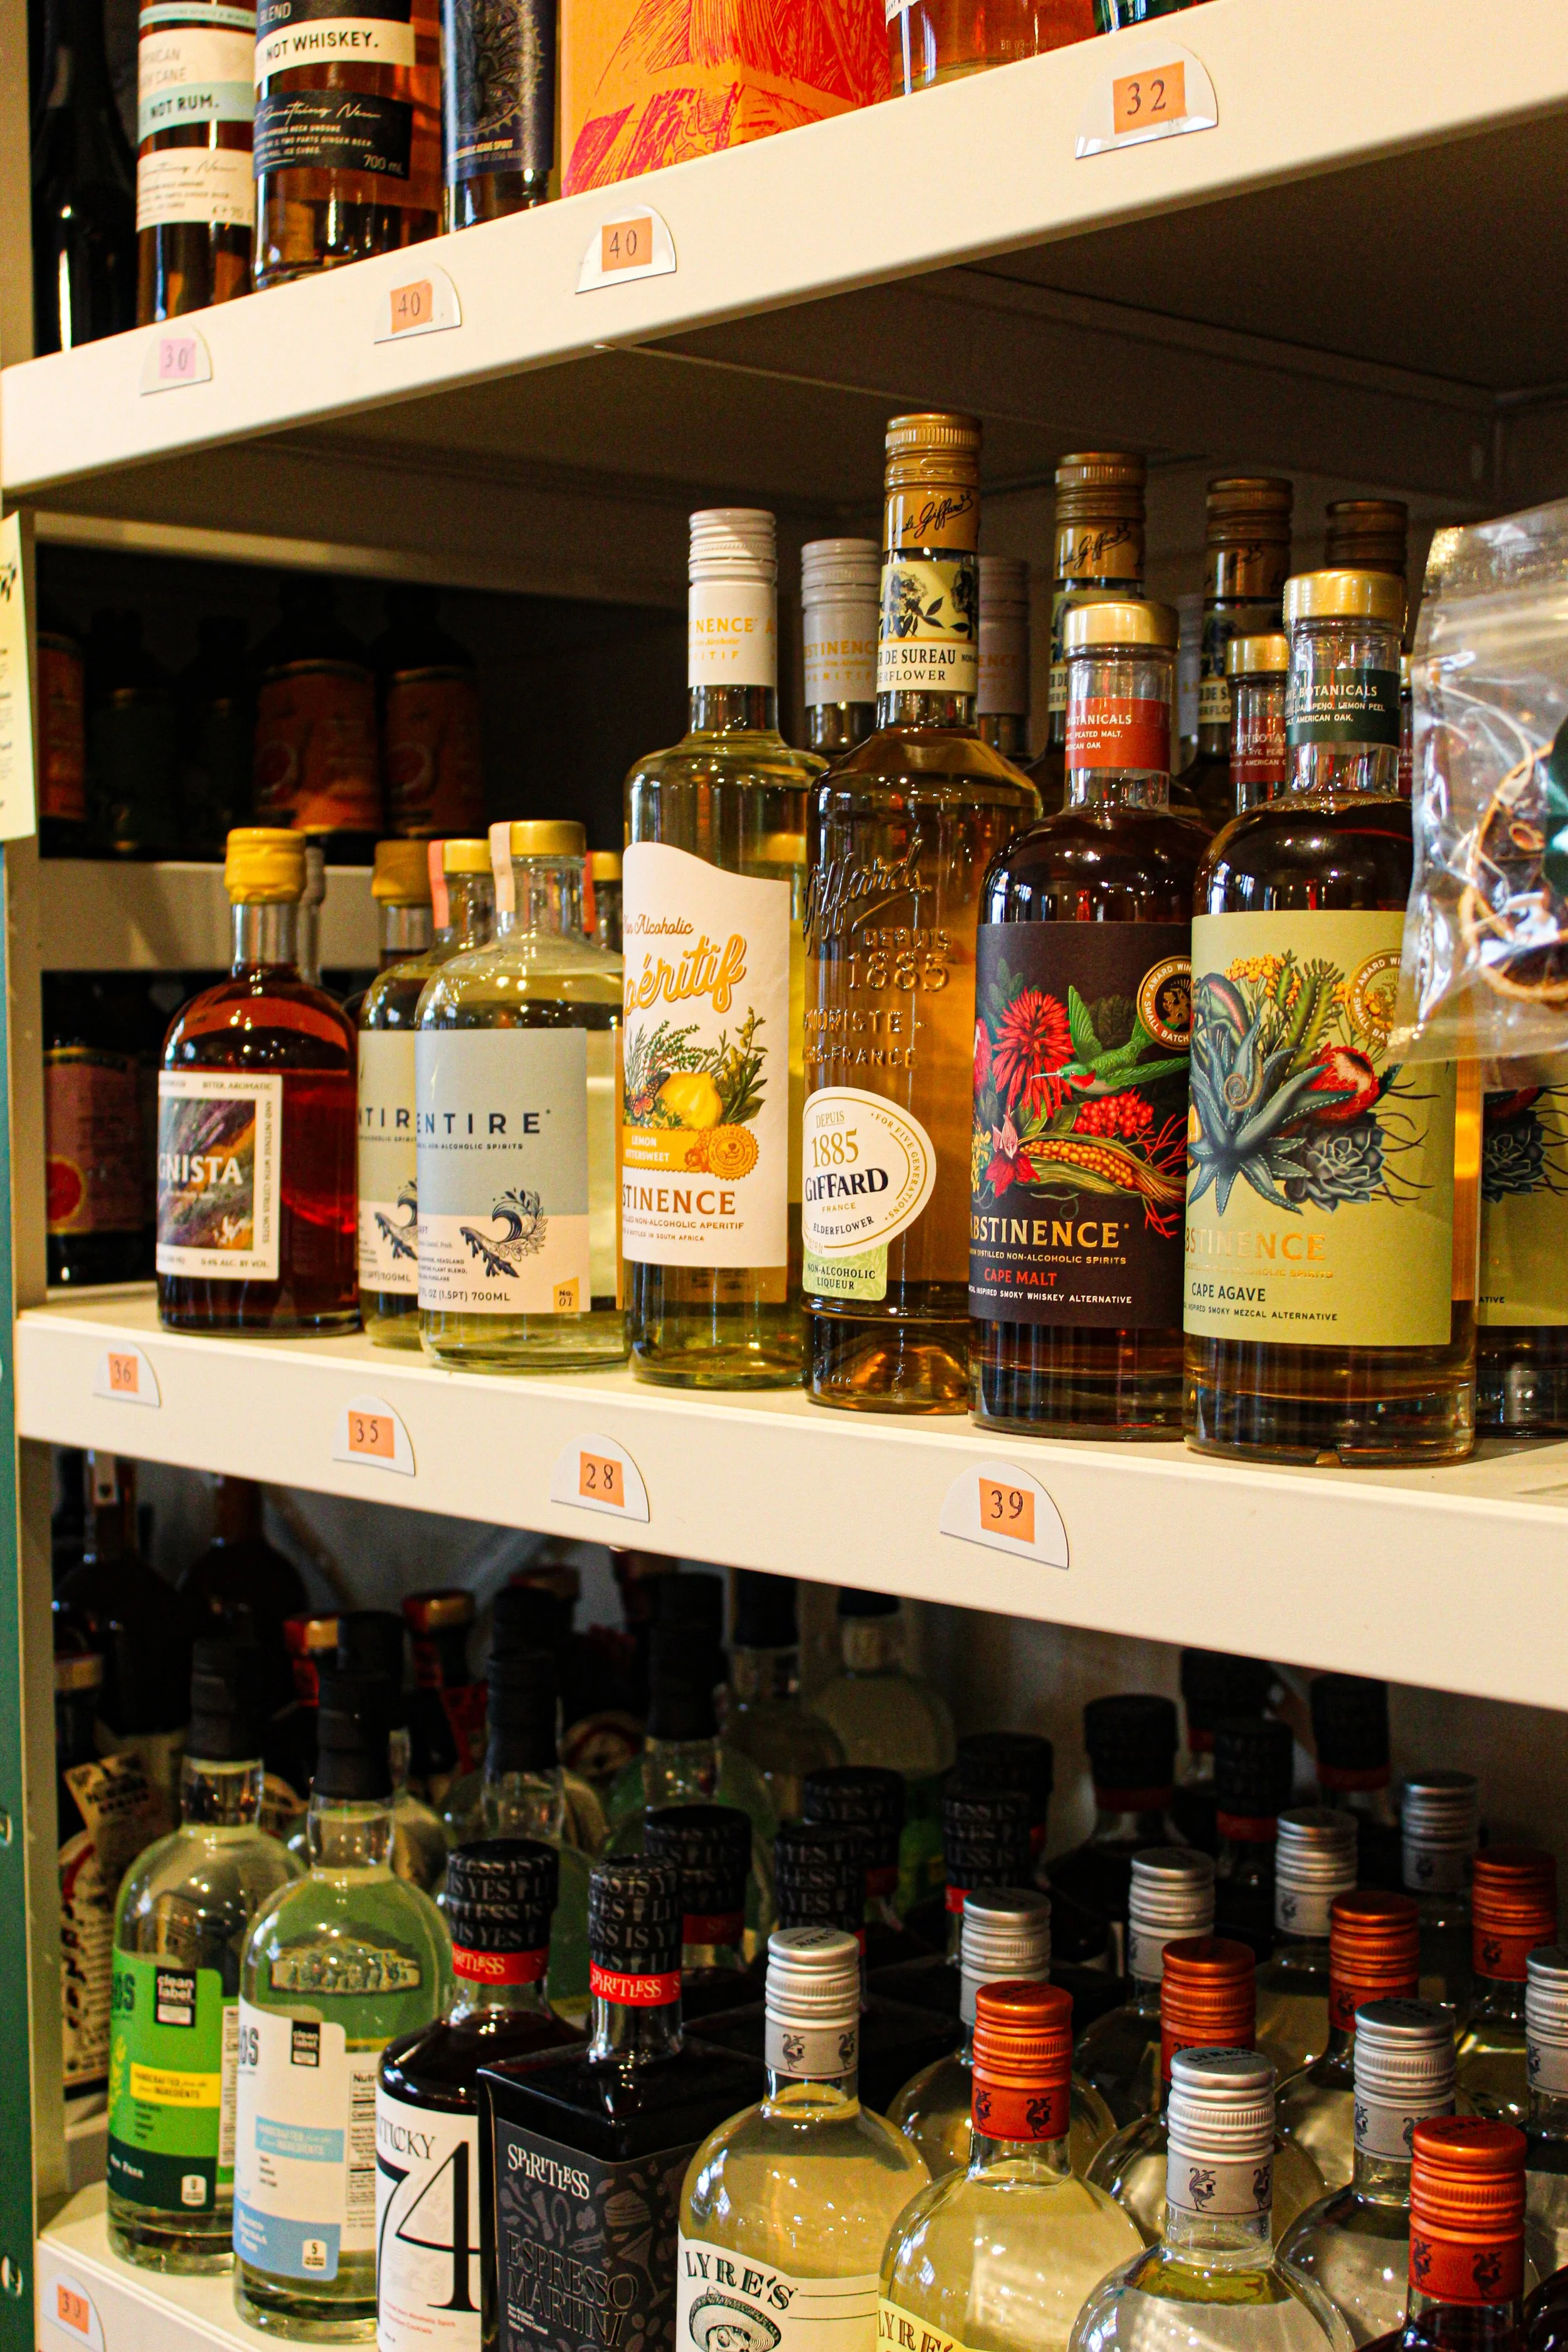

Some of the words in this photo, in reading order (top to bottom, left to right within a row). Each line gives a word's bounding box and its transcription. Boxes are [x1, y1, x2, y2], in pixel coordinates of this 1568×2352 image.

[267, 40, 289, 61] NOT
[293, 31, 379, 52] WHISKEY.
[151, 98, 172, 118] NOT
[177, 93, 219, 110] RUM.
[1127, 79, 1166, 115] 32
[363, 154, 386, 170] 700
[610, 230, 637, 259] 40
[398, 291, 420, 317] 40
[166, 344, 188, 371] 30
[688, 617, 753, 633] NENCE
[804, 640, 878, 658] STINENC
[885, 649, 897, 665] DE
[901, 649, 956, 665] SUREAU
[1299, 684, 1377, 697] BOTANICALS
[1338, 702, 1365, 710] LEMON
[1067, 714, 1132, 727] BOTANICALS
[1296, 714, 1330, 723] AMERICAN
[635, 914, 694, 935] Alcoholic
[622, 934, 746, 1019] péritif
[848, 951, 950, 992] 1885
[1147, 965, 1174, 990] AWARD
[1177, 963, 1192, 972] WIN
[1357, 957, 1386, 987] AWARD
[1390, 955, 1402, 965] WI
[1143, 1000, 1160, 1032] SMALL
[1160, 1029, 1189, 1043] BATCH
[1353, 997, 1369, 1030] SMALL
[1372, 1027, 1391, 1042] BAT
[815, 1110, 845, 1128] DEPUIS
[875, 1114, 894, 1128] FOR
[632, 1135, 657, 1147] LEMON
[894, 1127, 914, 1148] FIVE
[812, 1127, 859, 1168] 1885
[888, 1151, 921, 1218] GENERATIONS
[822, 1202, 856, 1213] FRANCE
[635, 1217, 697, 1228] NON-ALCOHOLIC
[813, 1216, 874, 1235] ELDERFLOWER
[1006, 1252, 1082, 1263] NON-ALCOHOLIC
[1086, 1256, 1126, 1264] SPIRITS
[807, 1263, 876, 1279] NON-ALCOHOLIC
[984, 1267, 1012, 1283] CAPE
[1015, 1271, 1057, 1286] MALT
[817, 1276, 855, 1290] LIQUEUR
[1192, 1282, 1214, 1298] CAPE
[1217, 1285, 1266, 1302] AGAVE
[428, 1289, 437, 1299] OZ
[438, 1290, 468, 1302] (1.5PT)
[471, 1291, 511, 1301] 700ML
[559, 1297, 573, 1307] 01
[976, 1286, 997, 1296] INSPIRED
[1000, 1290, 1024, 1300] SMOKY
[1027, 1293, 1064, 1302] WHISKEY
[1069, 1295, 1132, 1304] ALTERNATIVE
[1208, 1306, 1230, 1315] SMOKY
[1234, 1308, 1267, 1318] MEZCAL
[1271, 1311, 1338, 1321] ALTERNATIVE
[114, 1360, 130, 1383] 36
[356, 1419, 378, 1443] 35
[585, 1463, 613, 1490] 28
[990, 1490, 1024, 1519] 39
[467, 1877, 511, 1900] YES
[157, 1974, 194, 1989] clean
[158, 1986, 192, 2000] label
[292, 2030, 319, 2040] clean
[352, 2072, 376, 2083] Nutr
[507, 2143, 590, 2200] SPIRITLESS
[312, 2242, 317, 2254] 5
[506, 2229, 638, 2310] ESPRESSO
[685, 2251, 794, 2311] LYRE'S
[506, 2265, 628, 2347] MARTINI
